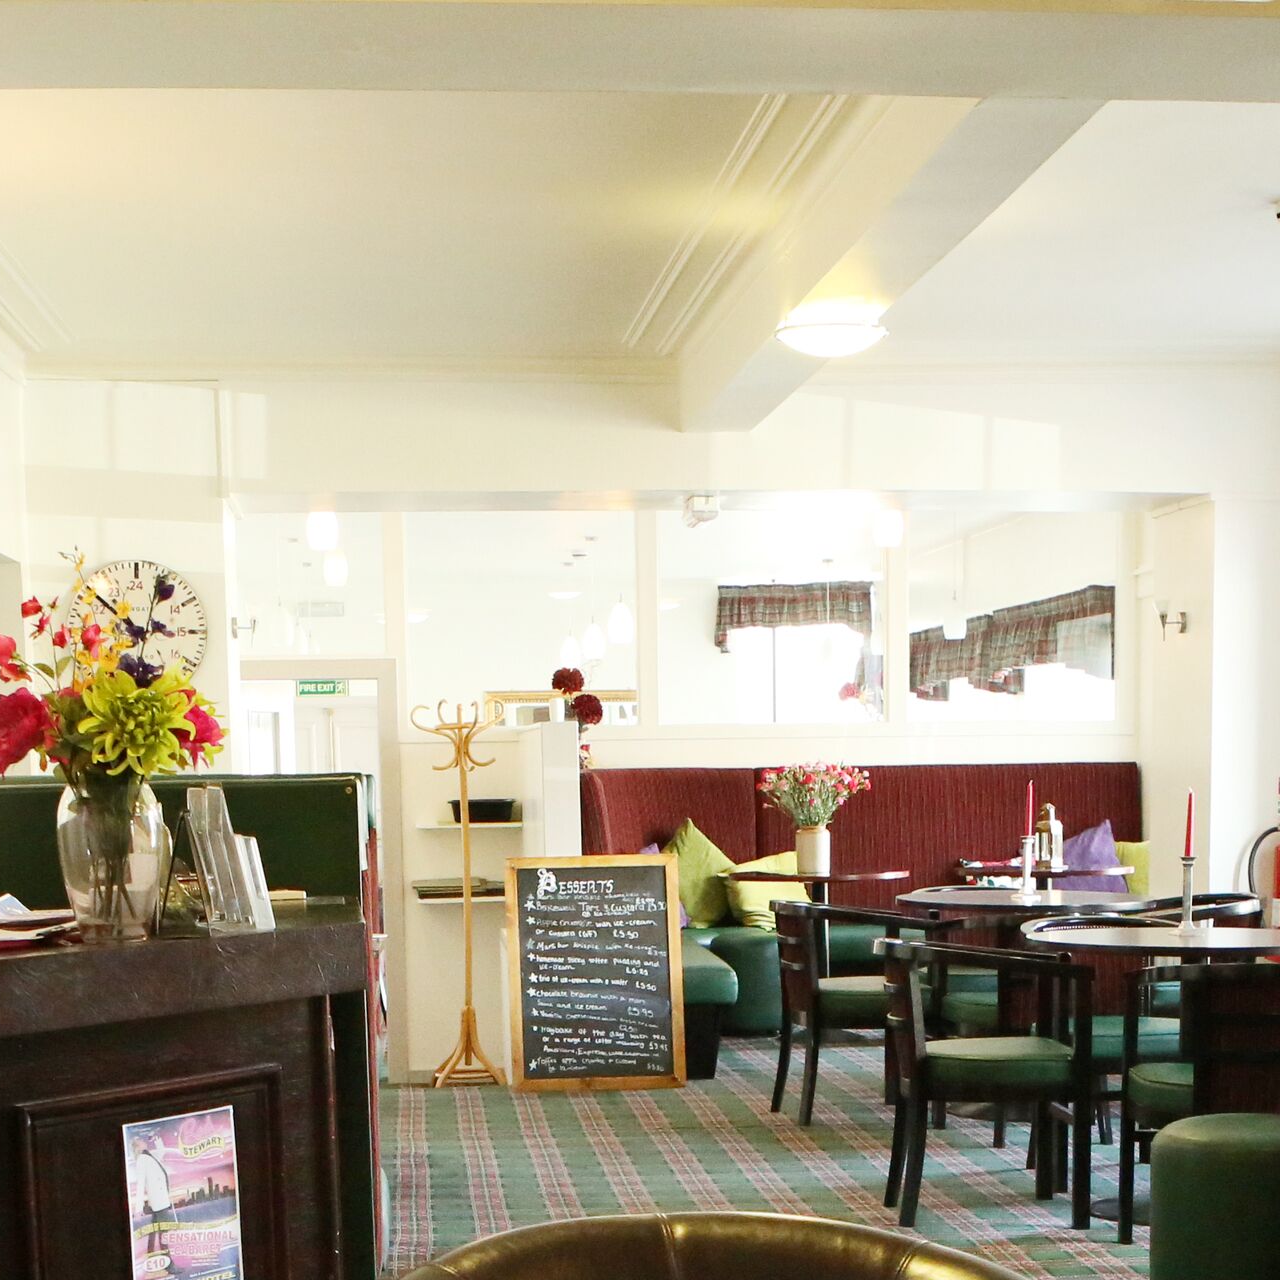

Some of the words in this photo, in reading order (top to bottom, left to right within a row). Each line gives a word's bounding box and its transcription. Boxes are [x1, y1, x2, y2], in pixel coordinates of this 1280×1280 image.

[129, 581, 143, 591] 24
[170, 605, 180, 614] 14
[177, 627, 186, 637] 15
[171, 649, 180, 659] 16
[299, 683, 317, 692] FIRE
[317, 683, 335, 692] EXIT
[579, 902, 600, 911] Tart
[610, 899, 645, 912] Custard
[183, 1137, 222, 1155] STEWART
[161, 1231, 235, 1243] SENSATIONAL
[174, 1243, 221, 1256] CABARET
[146, 1258, 166, 1270] £10
